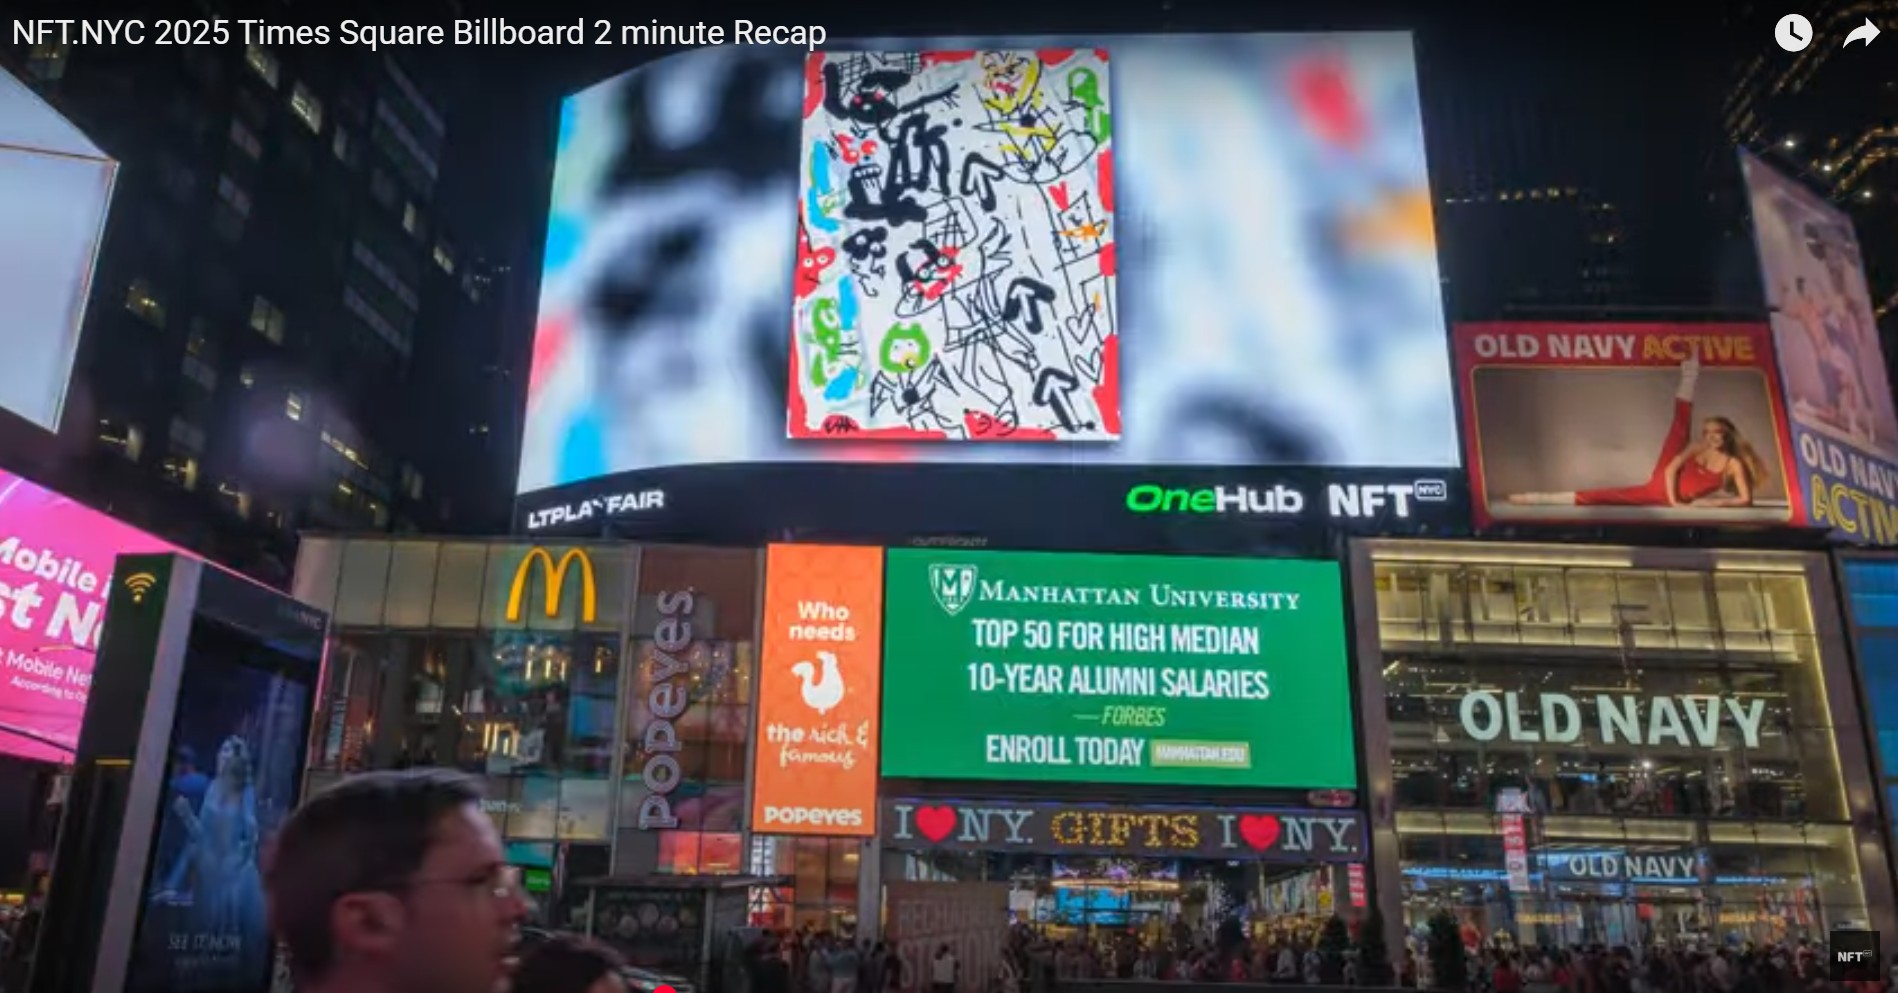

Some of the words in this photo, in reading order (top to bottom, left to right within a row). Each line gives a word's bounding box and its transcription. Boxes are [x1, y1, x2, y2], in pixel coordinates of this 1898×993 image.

[1474, 334, 1540, 359] OLD
[1548, 334, 1636, 361] NAVY
[1642, 335, 1756, 361] ACTIVE
[1801, 432, 1848, 478] OLD
[1850, 452, 1898, 500] NAV
[1126, 484, 1304, 513] OneHub
[1328, 483, 1413, 518] NFT
[797, 601, 850, 621] Who
[979, 580, 1140, 605] MANHATTAN
[1149, 584, 1300, 611] UNIVERSITY
[788, 622, 856, 642] needs
[973, 619, 1016, 649] TOP
[1023, 620, 1053, 650] 50
[1058, 620, 1104, 651] FOR
[1109, 622, 1166, 653] HIGH
[1171, 624, 1259, 655] MEDIAN
[6, 649, 64, 680] Mobile
[968, 663, 1063, 694] 10-YEAR
[1068, 666, 1156, 697] ALUMNI
[1161, 669, 1270, 700] SALARIES
[766, 722, 805, 744] the
[808, 723, 851, 746] rich
[1459, 690, 1582, 744] OLD
[1598, 693, 1766, 749] NAVY
[779, 743, 857, 770] famous
[986, 734, 1071, 765] ENROLL
[1075, 736, 1145, 766] TODAY
[893, 805, 915, 841] I
[1051, 811, 1200, 850] GIFTS
[1217, 813, 1239, 850] I
[1569, 854, 1619, 878] OLD
[1625, 855, 1696, 879] NAVY
